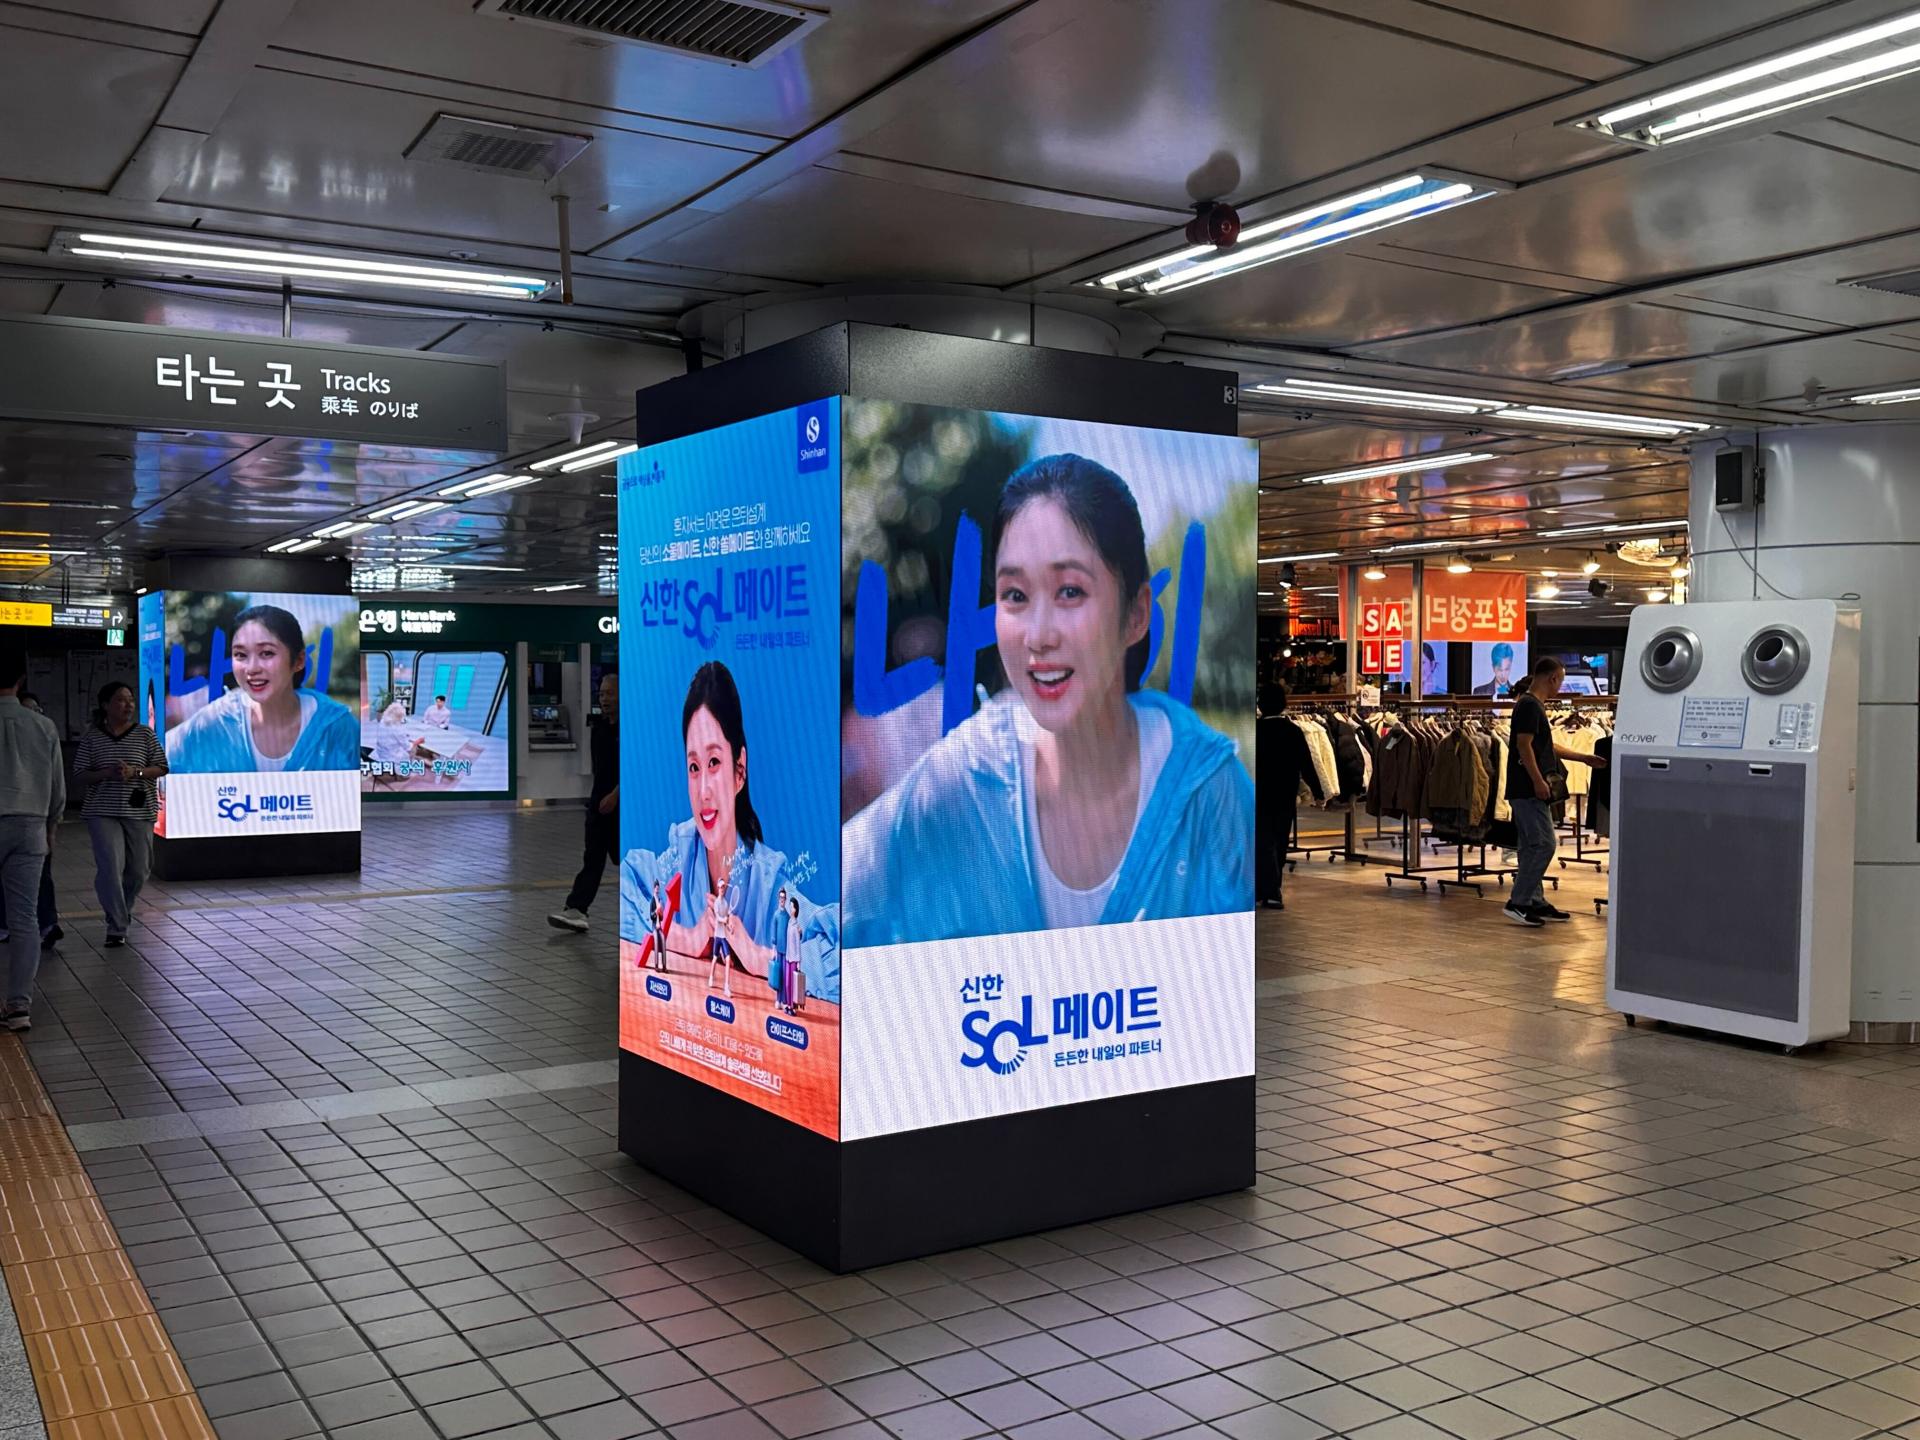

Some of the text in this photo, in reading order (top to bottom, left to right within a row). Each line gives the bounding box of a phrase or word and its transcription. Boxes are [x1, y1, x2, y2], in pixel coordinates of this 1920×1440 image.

[157, 354, 301, 410] 타는 곳
[320, 368, 391, 394] Tracks
[321, 396, 359, 416] 乘车
[1227, 387, 1234, 403] 3
[369, 401, 419, 419] のりば
[801, 447, 826, 461] Shinhan
[674, 515, 705, 537] 혼자서는
[706, 509, 730, 530] 어려운
[640, 543, 662, 566] 당신의
[703, 535, 721, 557] 신한
[764, 521, 811, 549] 함께하세요
[640, 578, 680, 627] 신한
[734, 564, 810, 621] 메이트
[598, 616, 620, 634] Gl
[400, 760, 425, 775] 공식
[431, 759, 472, 776] 후원사
[218, 786, 237, 796] 신한
[260, 795, 313, 812] 메이트
[960, 974, 1004, 1004] 신한
[1052, 986, 1162, 1040] 메이트
[769, 1020, 805, 1045] 라이프스타일
[1054, 1038, 1162, 1067] 든든한 내일의 파트너
